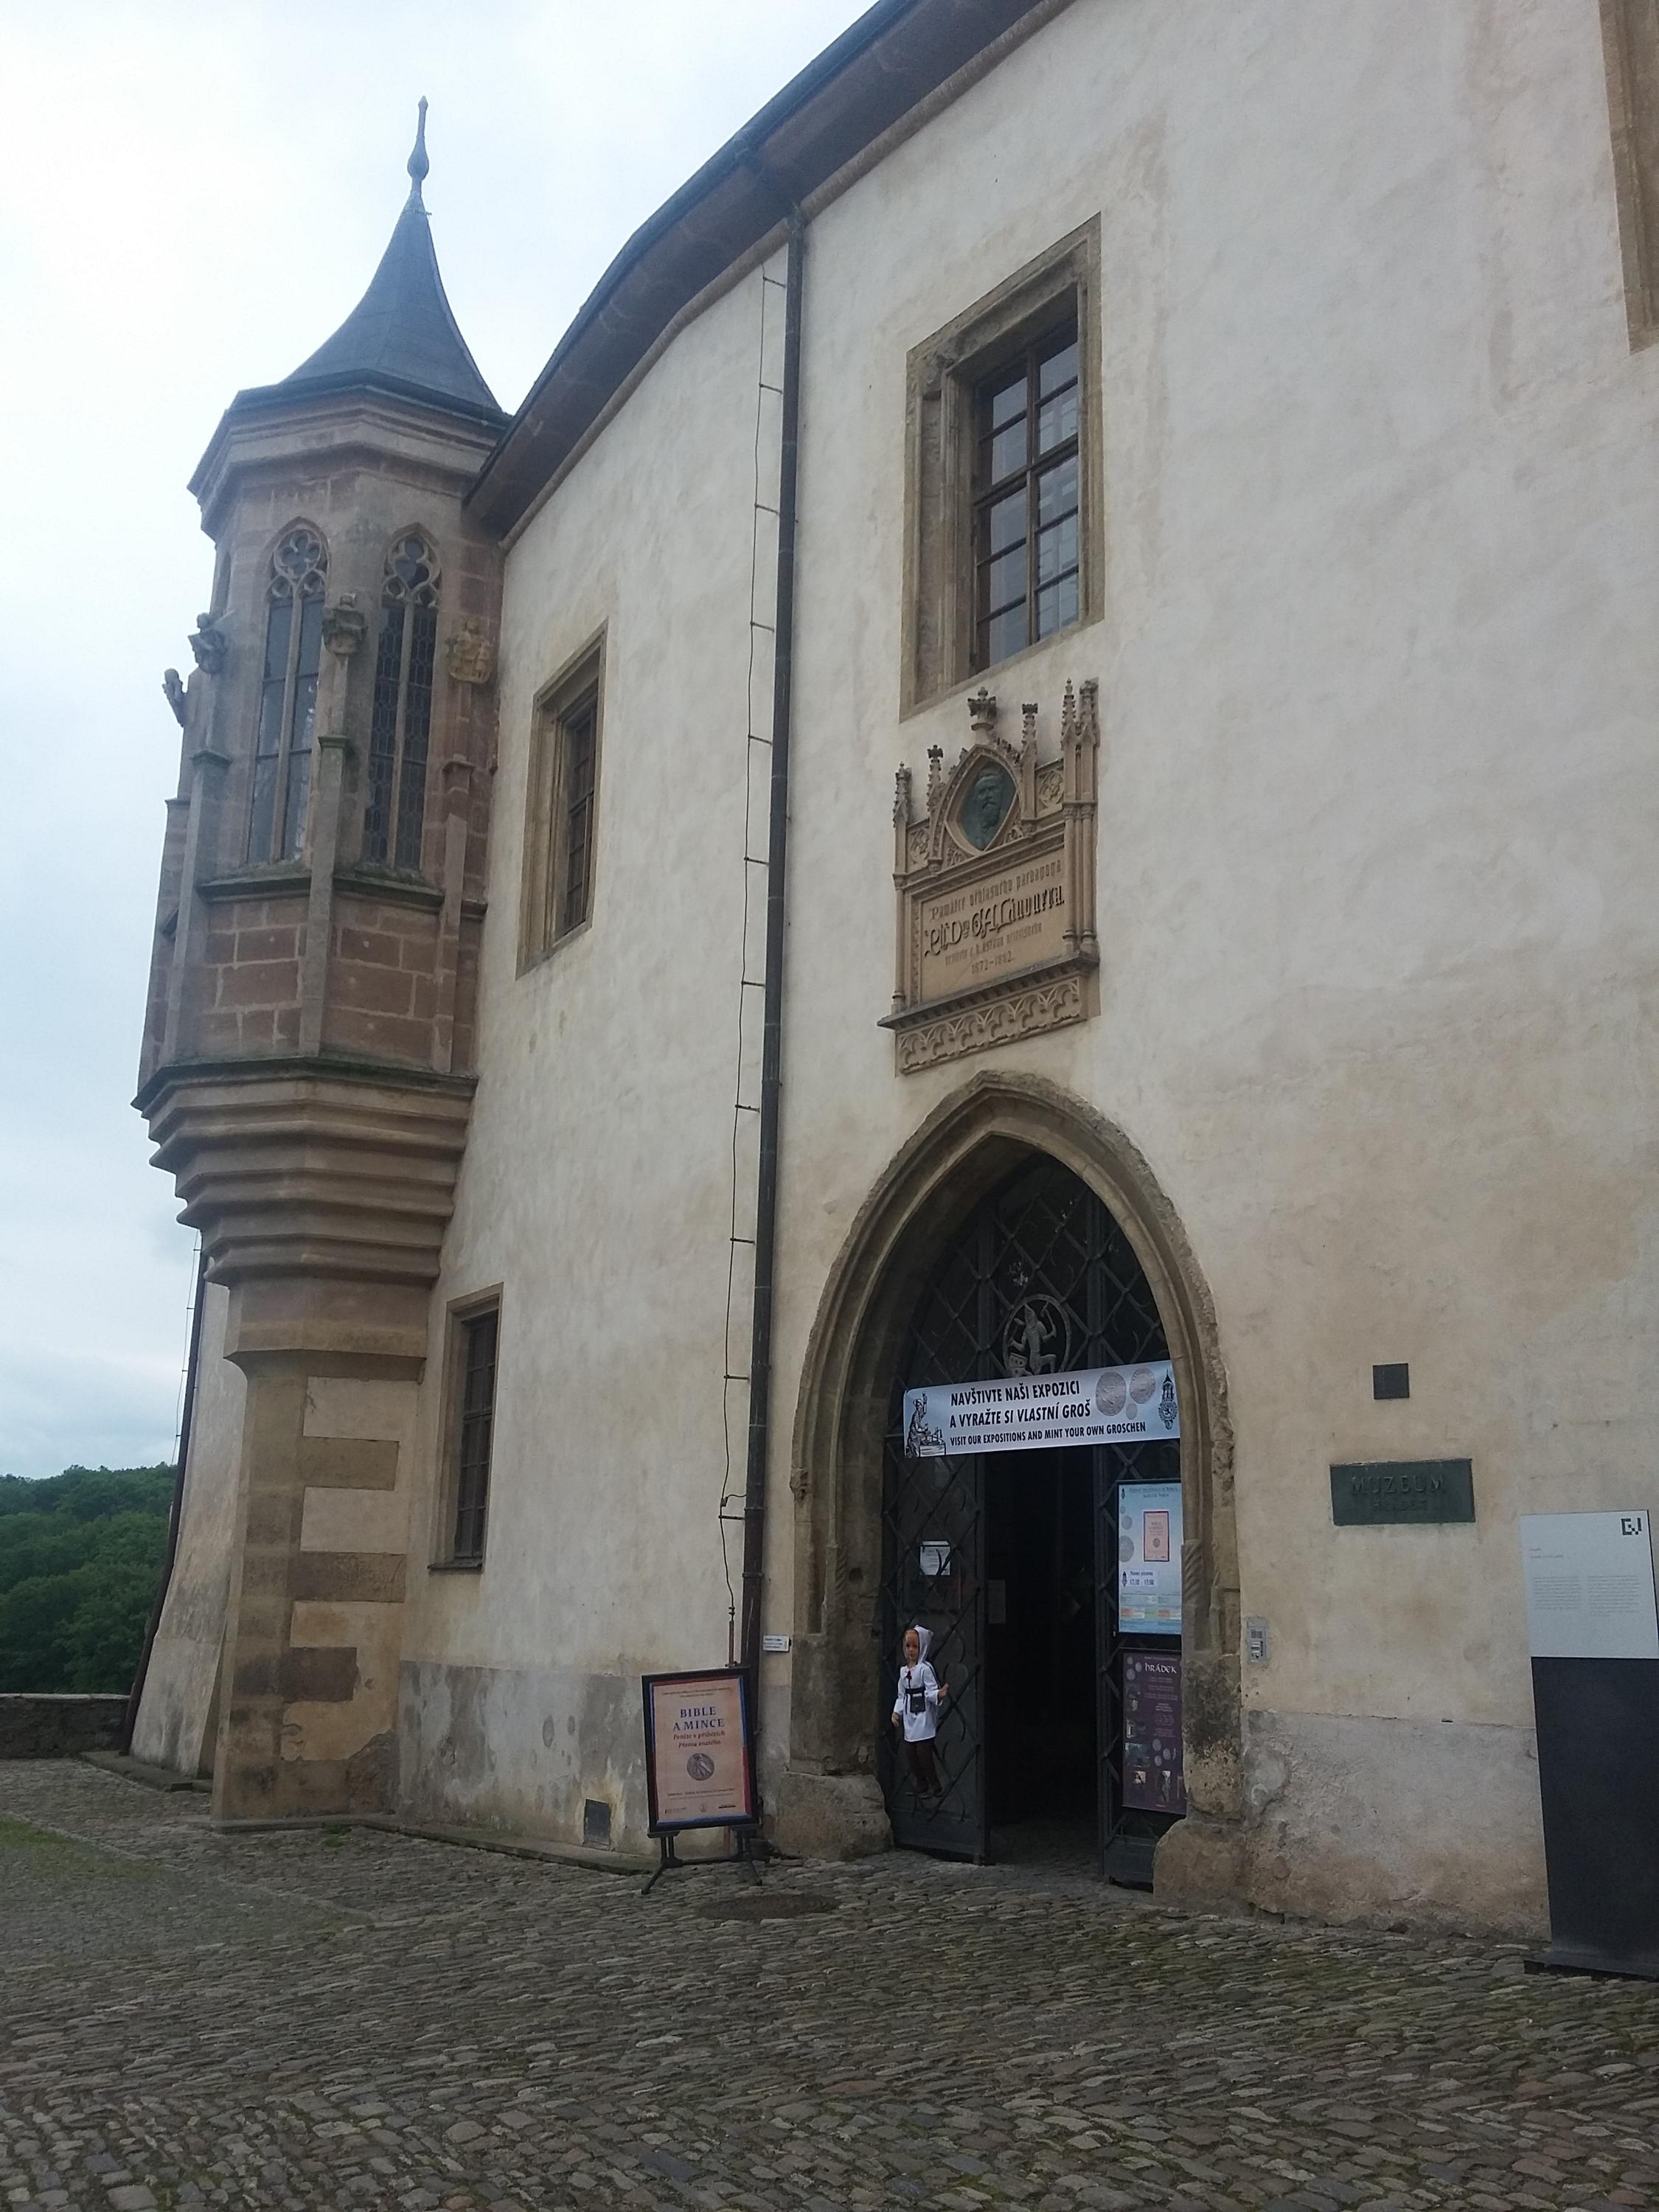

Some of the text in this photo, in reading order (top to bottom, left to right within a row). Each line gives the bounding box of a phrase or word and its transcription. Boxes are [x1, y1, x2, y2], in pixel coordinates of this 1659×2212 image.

[950, 1380, 1079, 1406] NAVŠTIVTE NAŠI EXPOZICI
[950, 1399, 1091, 1428] A VYRAŽTE SI VLASTNÍ GROŠ
[950, 1422, 1146, 1446] VISIT OUR EXPOSITIONS AND MINT YOUR OWN GROSCHEN
[1352, 1474, 1447, 1495] MUZEUM
[680, 1706, 717, 1718] BIBLE
[673, 1718, 725, 1731] A MINCE
